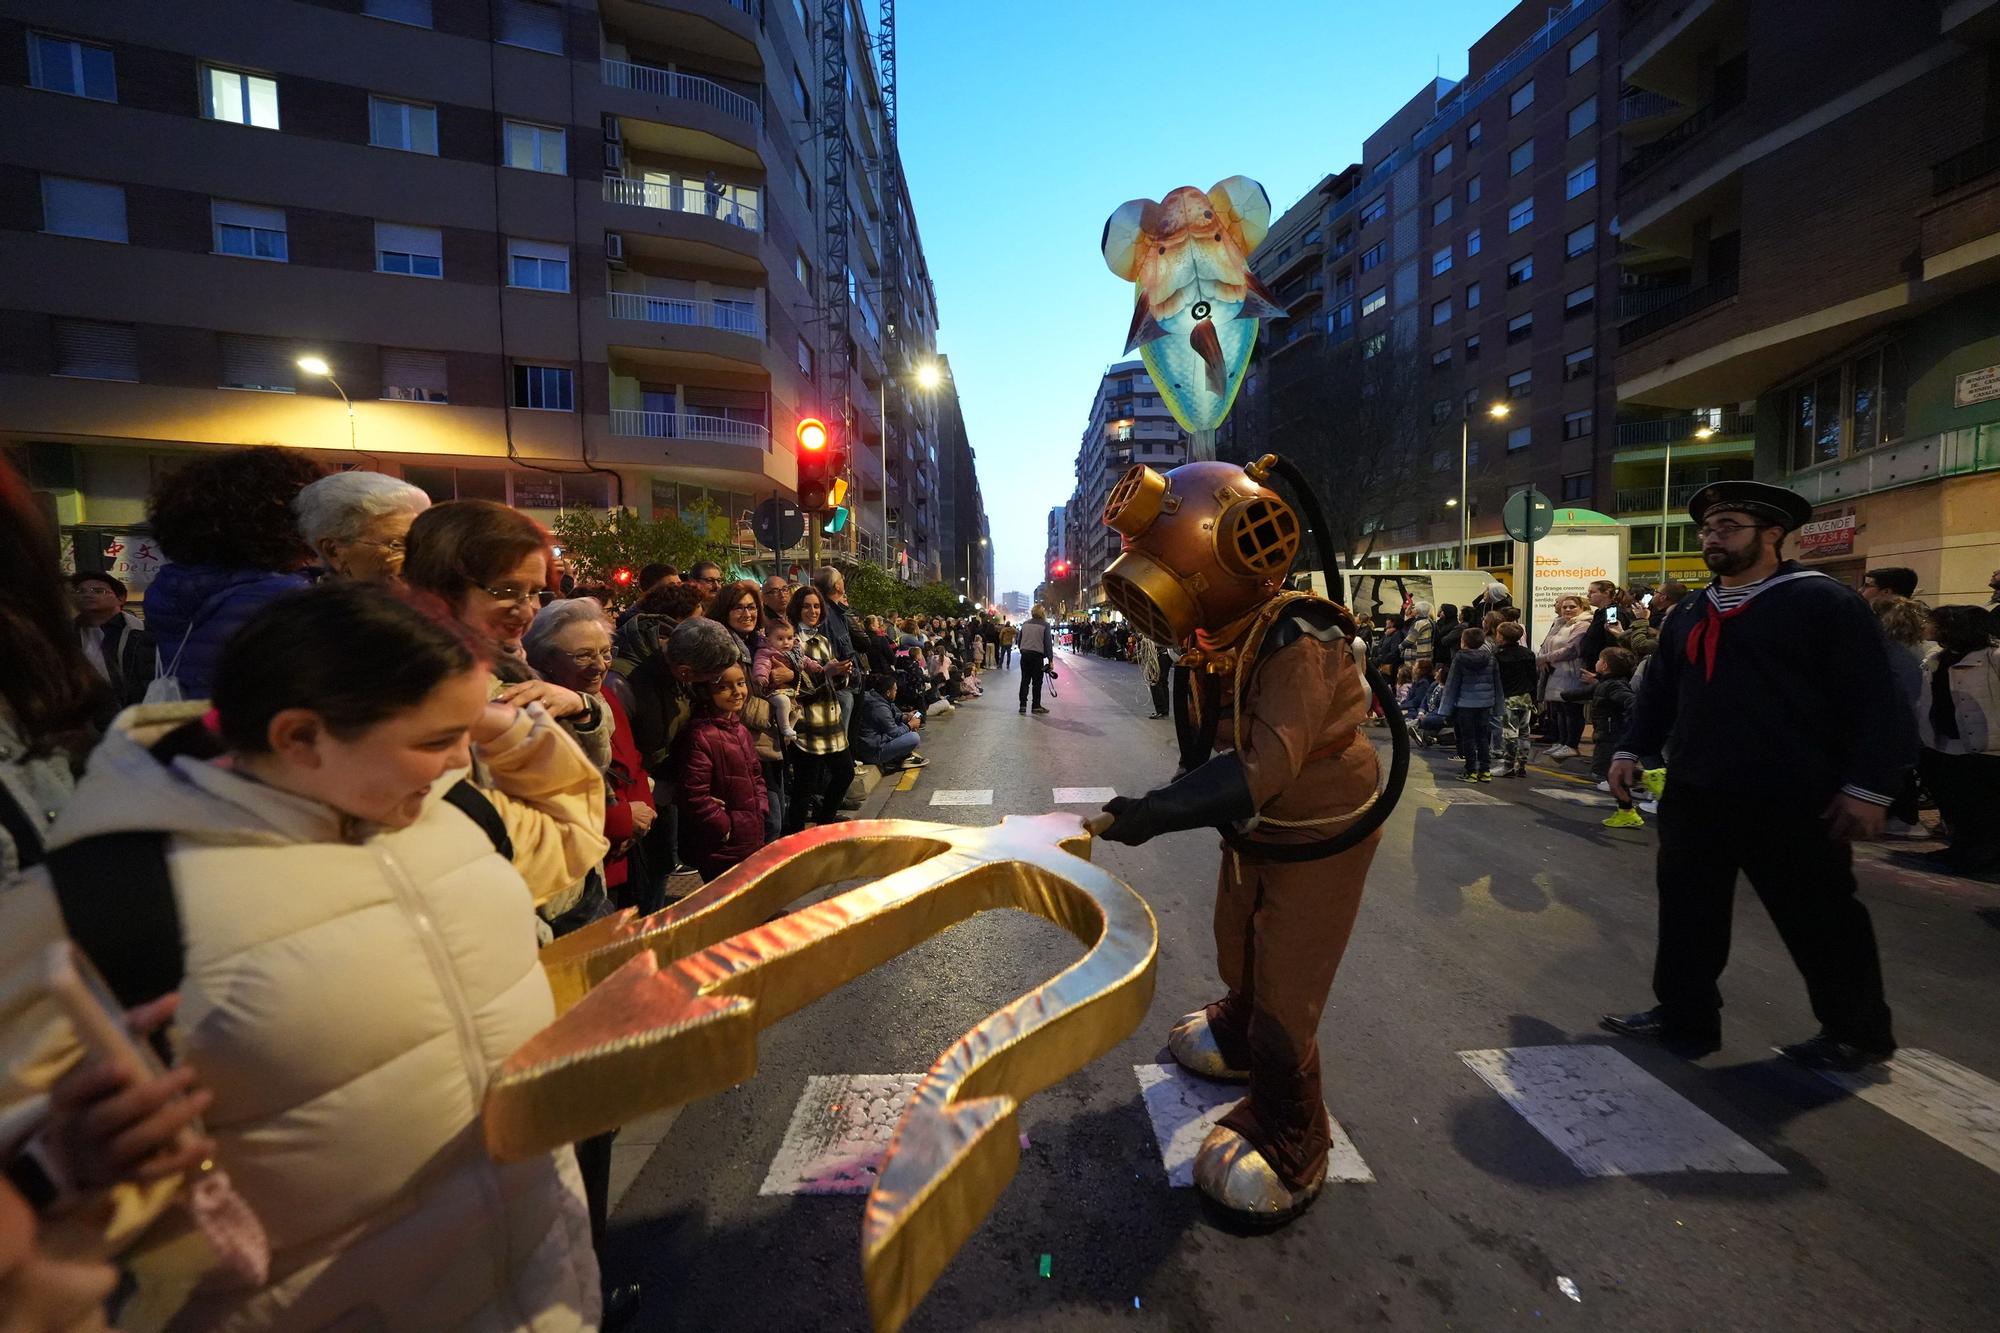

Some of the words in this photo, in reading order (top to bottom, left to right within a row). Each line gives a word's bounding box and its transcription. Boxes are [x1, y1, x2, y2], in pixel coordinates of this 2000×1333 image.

[1803, 524, 1815, 534] SE
[1817, 517, 1851, 531] VENDE
[1536, 555, 1560, 566] Des
[120, 562, 138, 572] De
[143, 562, 159, 572] Le
[1535, 566, 1607, 579] aconsejado
